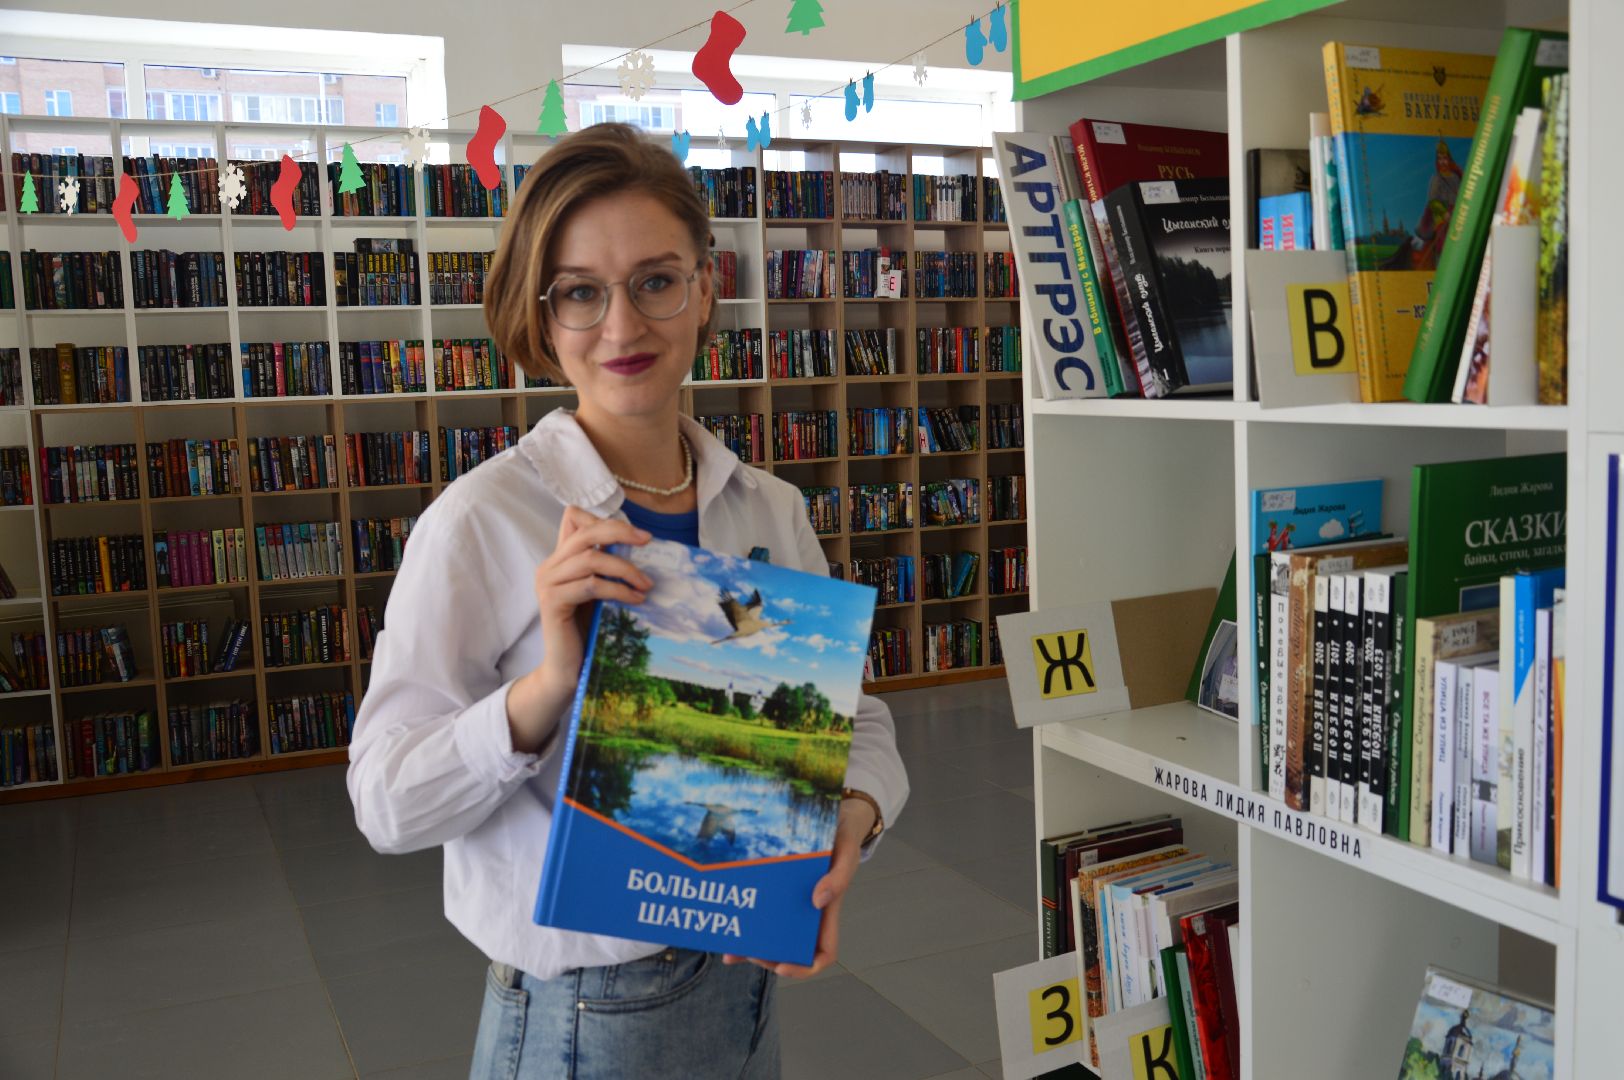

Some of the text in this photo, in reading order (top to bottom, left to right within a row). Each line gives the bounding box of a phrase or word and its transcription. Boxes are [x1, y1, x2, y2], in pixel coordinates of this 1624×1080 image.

[1404, 102, 1480, 122] ВАКУЛОВЫ
[1157, 165, 1195, 179] РУСЬ
[1162, 216, 1219, 233] Цыганский
[1004, 140, 1095, 391] АРТГРЭС
[1082, 271, 1089, 279] с
[1082, 277, 1101, 324] обнимку
[1092, 326, 1102, 335] В
[1303, 288, 1345, 368] В
[1317, 502, 1347, 513] Жарова
[1489, 481, 1554, 497] Лидия Жарова
[1035, 632, 1095, 695] Ж
[1315, 641, 1324, 666] 2010
[1330, 639, 1341, 666] 2017
[1345, 640, 1355, 666] 2019
[1374, 648, 1384, 679] 2023
[1313, 690, 1324, 753] ПОЭЗИЯ
[1328, 692, 1339, 760] ПОЭЗИЯ
[1343, 693, 1354, 762] ПОЭЗИЯ
[1361, 692, 1373, 760] ПОЭЗИЯ
[1371, 703, 1383, 759] ПОЭЗИЯ
[1438, 677, 1448, 764] УЛИЦА ИЗ УЛИЦ
[1480, 691, 1490, 774] ВСЕ ТА ЖЕ УЛИЦА
[1154, 766, 1363, 859] ЖАРОВА ЛИДИЯ ПАВЛОВНА
[1514, 748, 1525, 855] Прикосновение
[627, 868, 757, 910] БОЛЬШАЯ
[637, 901, 741, 938] ШАТУРА
[1041, 985, 1075, 1046] З
[1142, 1027, 1180, 1080] К
